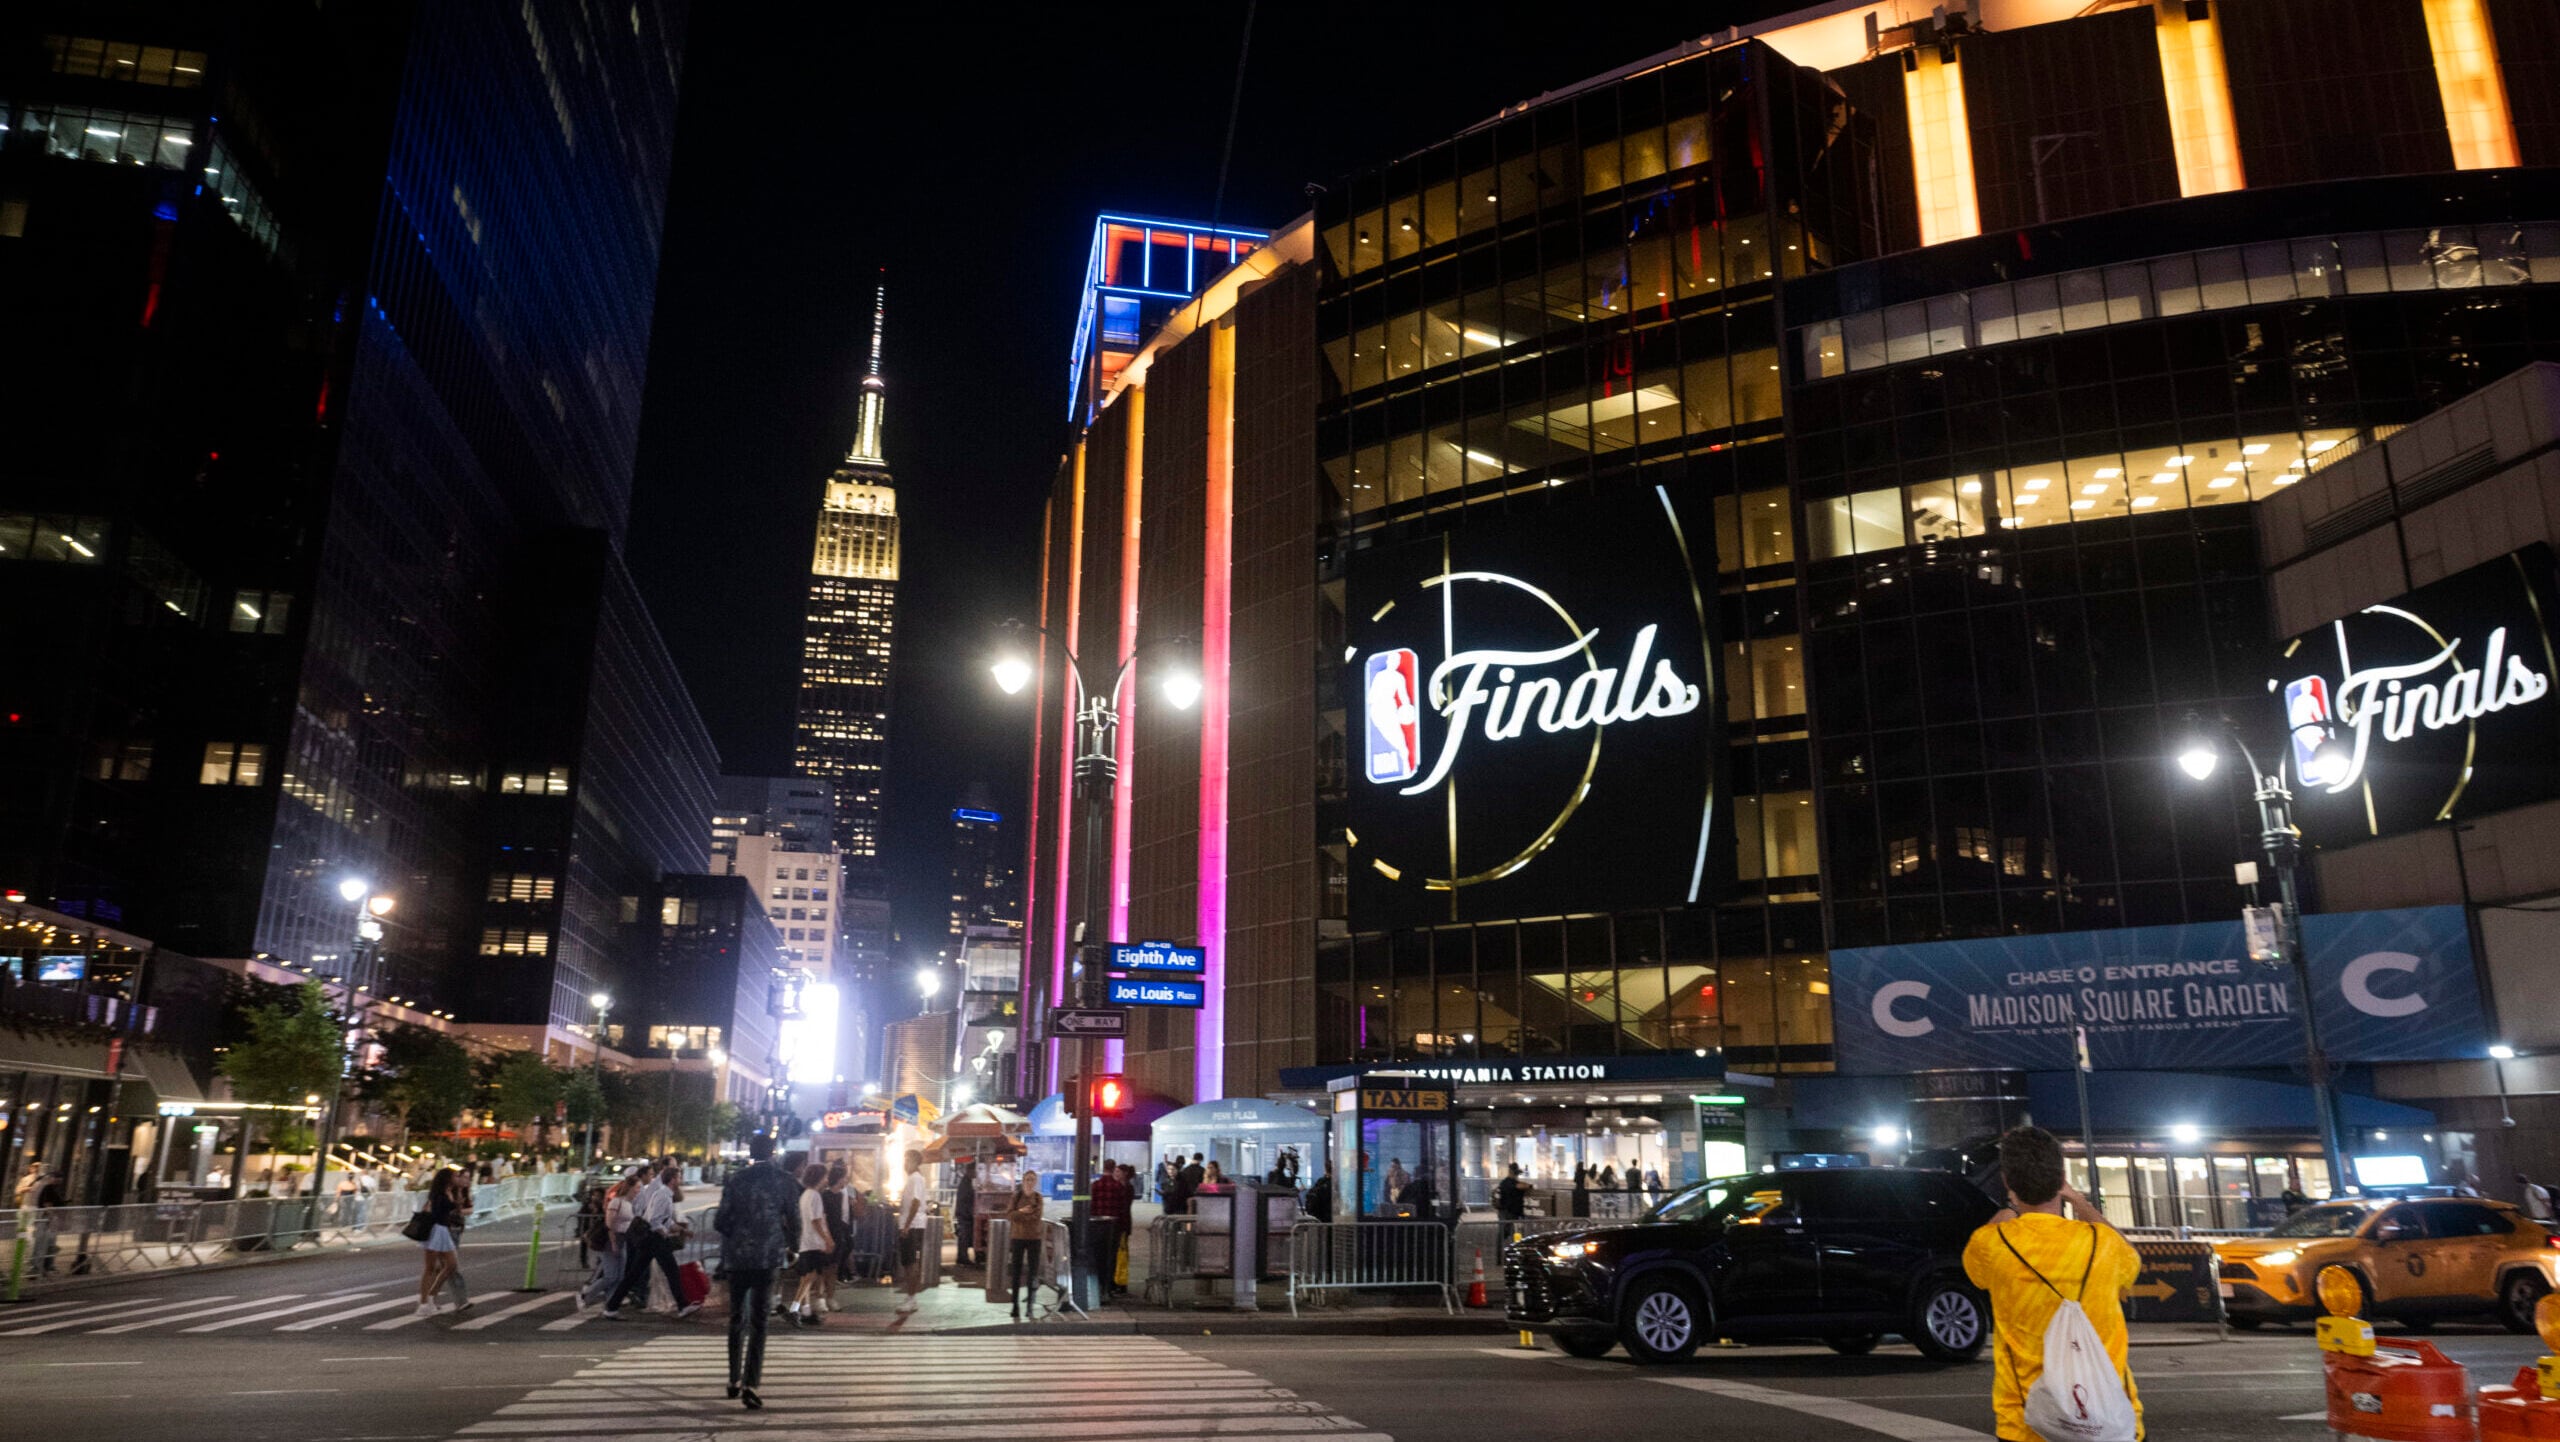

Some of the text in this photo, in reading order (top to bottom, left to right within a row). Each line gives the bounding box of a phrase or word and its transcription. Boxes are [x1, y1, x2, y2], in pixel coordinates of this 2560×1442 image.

[1399, 623, 1701, 796] Finals
[2326, 626, 2549, 794] Finals
[1116, 949, 1196, 967] Eighth Ave
[2007, 959, 2240, 986] CHASE ENTRANCE
[1115, 985, 1138, 999] Joe
[1140, 986, 1174, 1001] Louis
[1968, 982, 2290, 1027] MADISON SQUARE GARDEN
[1066, 1016, 1115, 1026] ONE WAY
[2100, 1024, 2134, 1033] MOST
[2138, 1021, 2191, 1031] FAMOUS
[1521, 1064, 1606, 1080] STATION
[1366, 1090, 1419, 1109] TAXI
[1233, 1110, 1259, 1121] PLAZA
